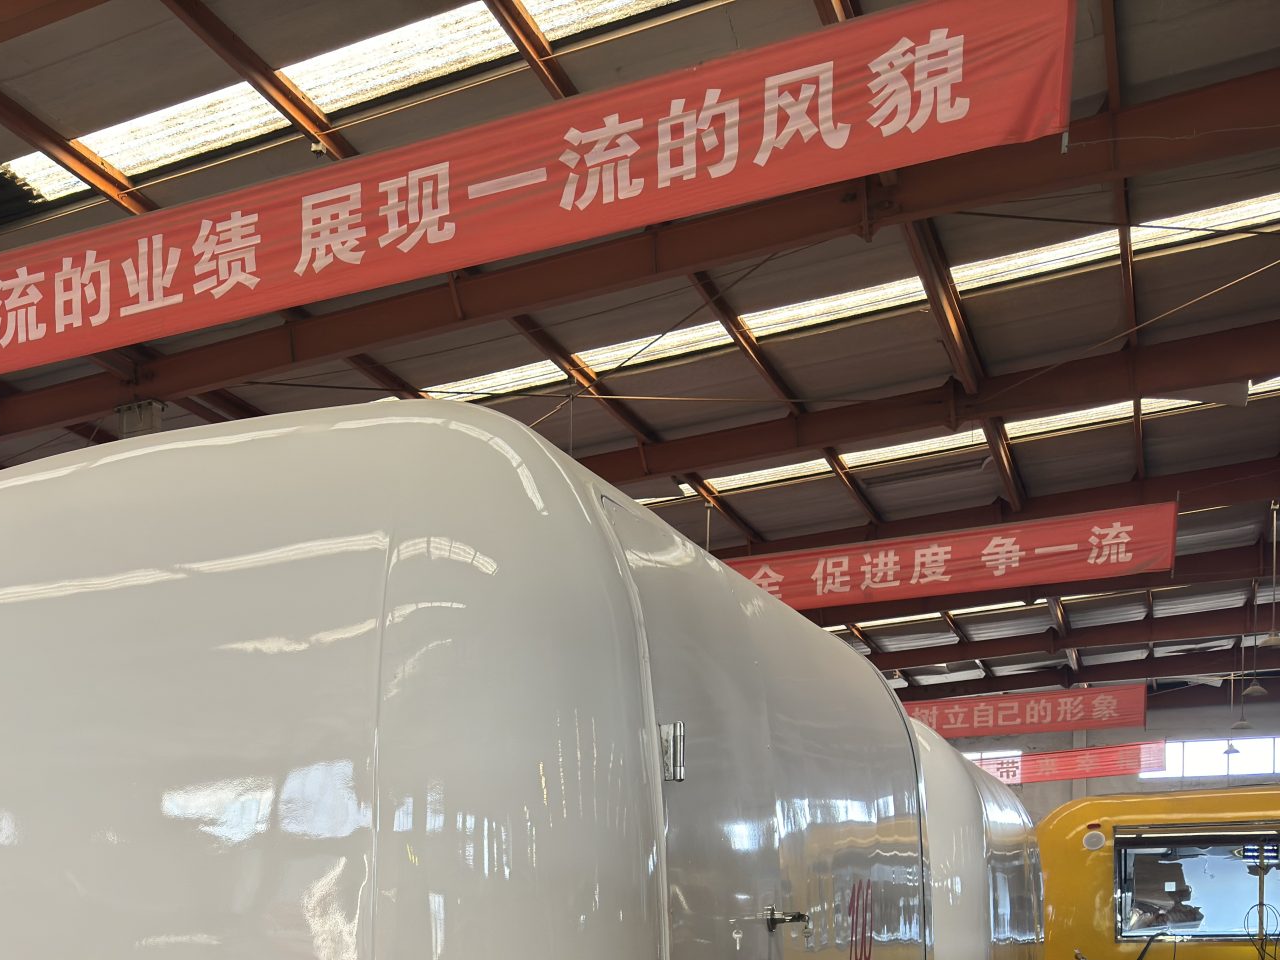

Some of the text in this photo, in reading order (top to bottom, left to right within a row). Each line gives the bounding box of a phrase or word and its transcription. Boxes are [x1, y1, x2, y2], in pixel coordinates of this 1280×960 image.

[294, 28, 971, 277] 展现一流的风貌
[811, 543, 953, 597] 促进度
[981, 521, 1134, 577] 争一流
[911, 692, 1120, 730] 树立自己的形象
